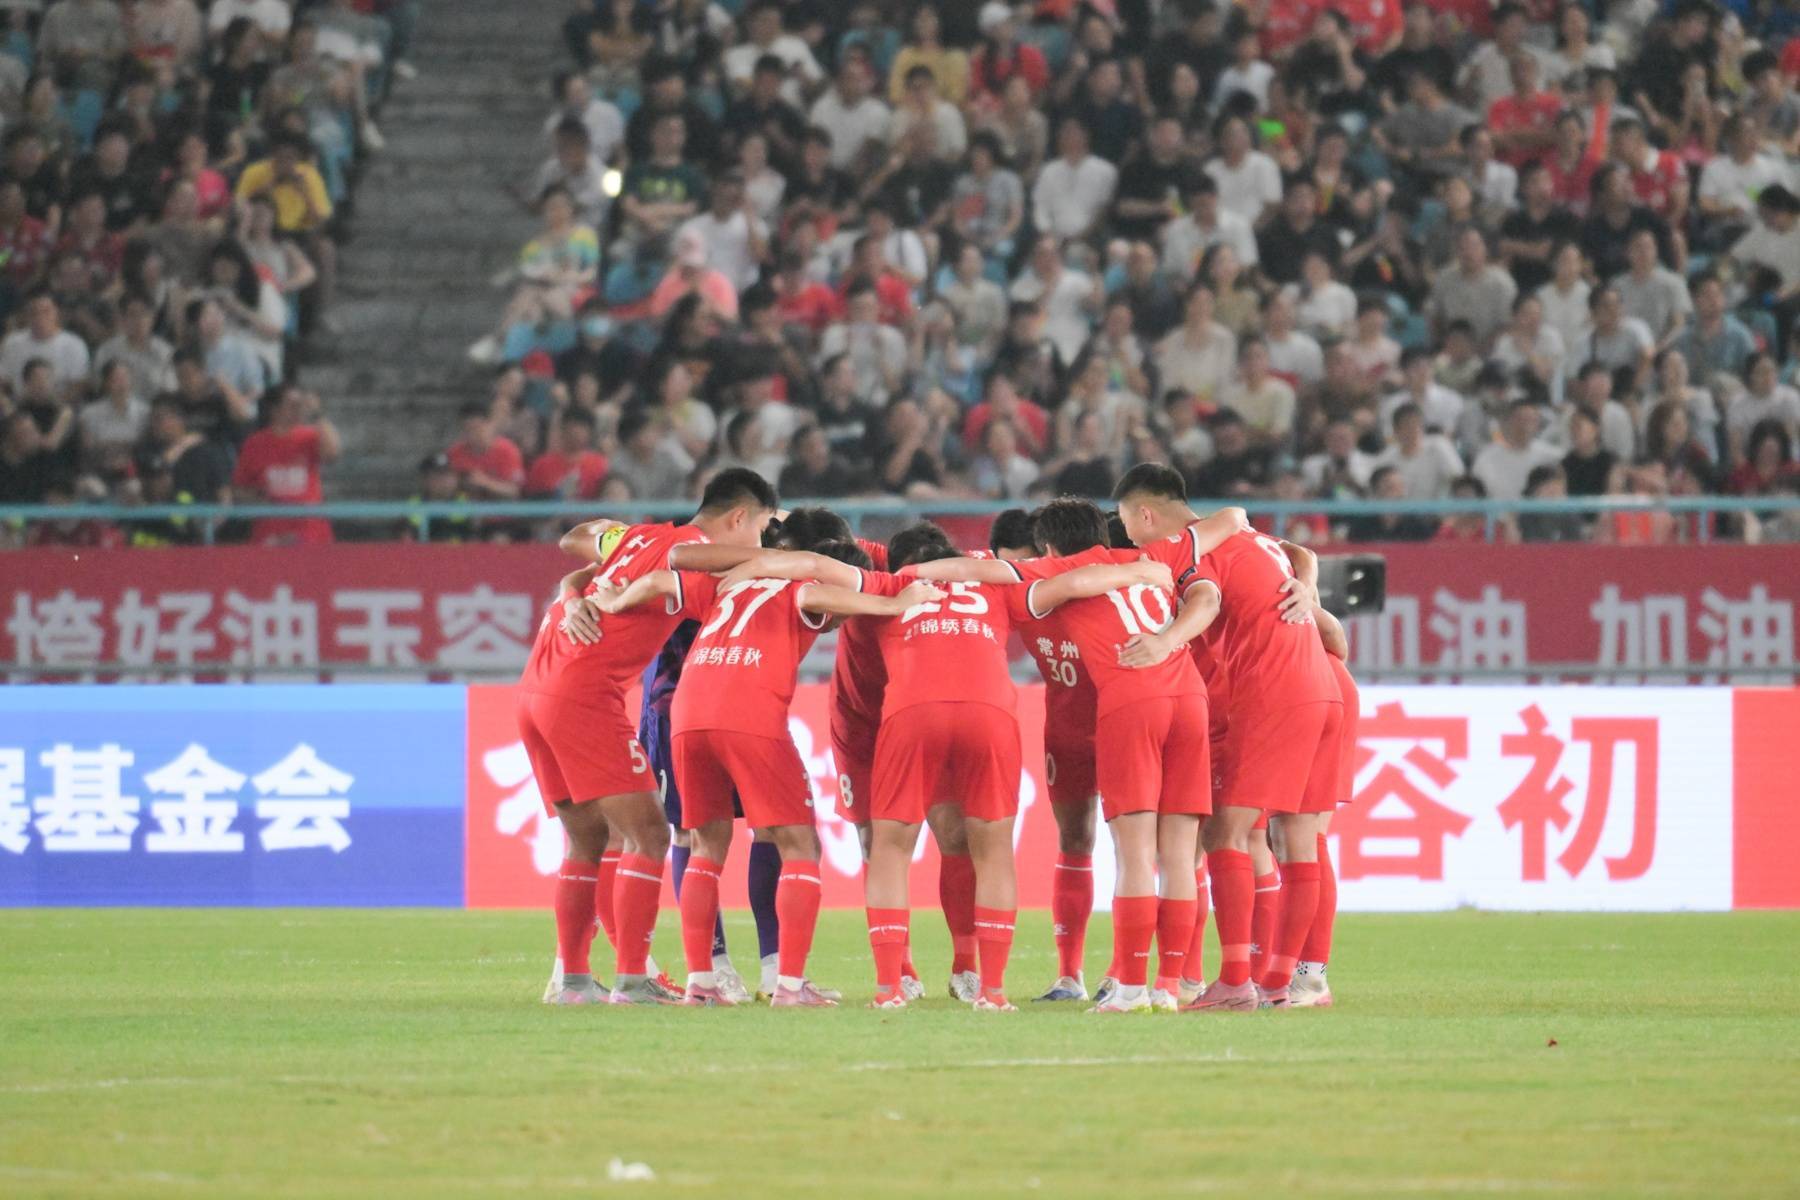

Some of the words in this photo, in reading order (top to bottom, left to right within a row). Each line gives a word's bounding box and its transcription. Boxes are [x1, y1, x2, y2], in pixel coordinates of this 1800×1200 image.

[700, 577, 792, 638] 37
[1107, 583, 1174, 635] 10
[1036, 637, 1079, 660] 常州
[1341, 584, 1526, 684] 加油
[1590, 583, 1794, 684] 加油
[1047, 658, 1078, 687] 30
[628, 738, 648, 774] 5
[840, 774, 854, 808] 8
[1328, 700, 1659, 882] 容初
